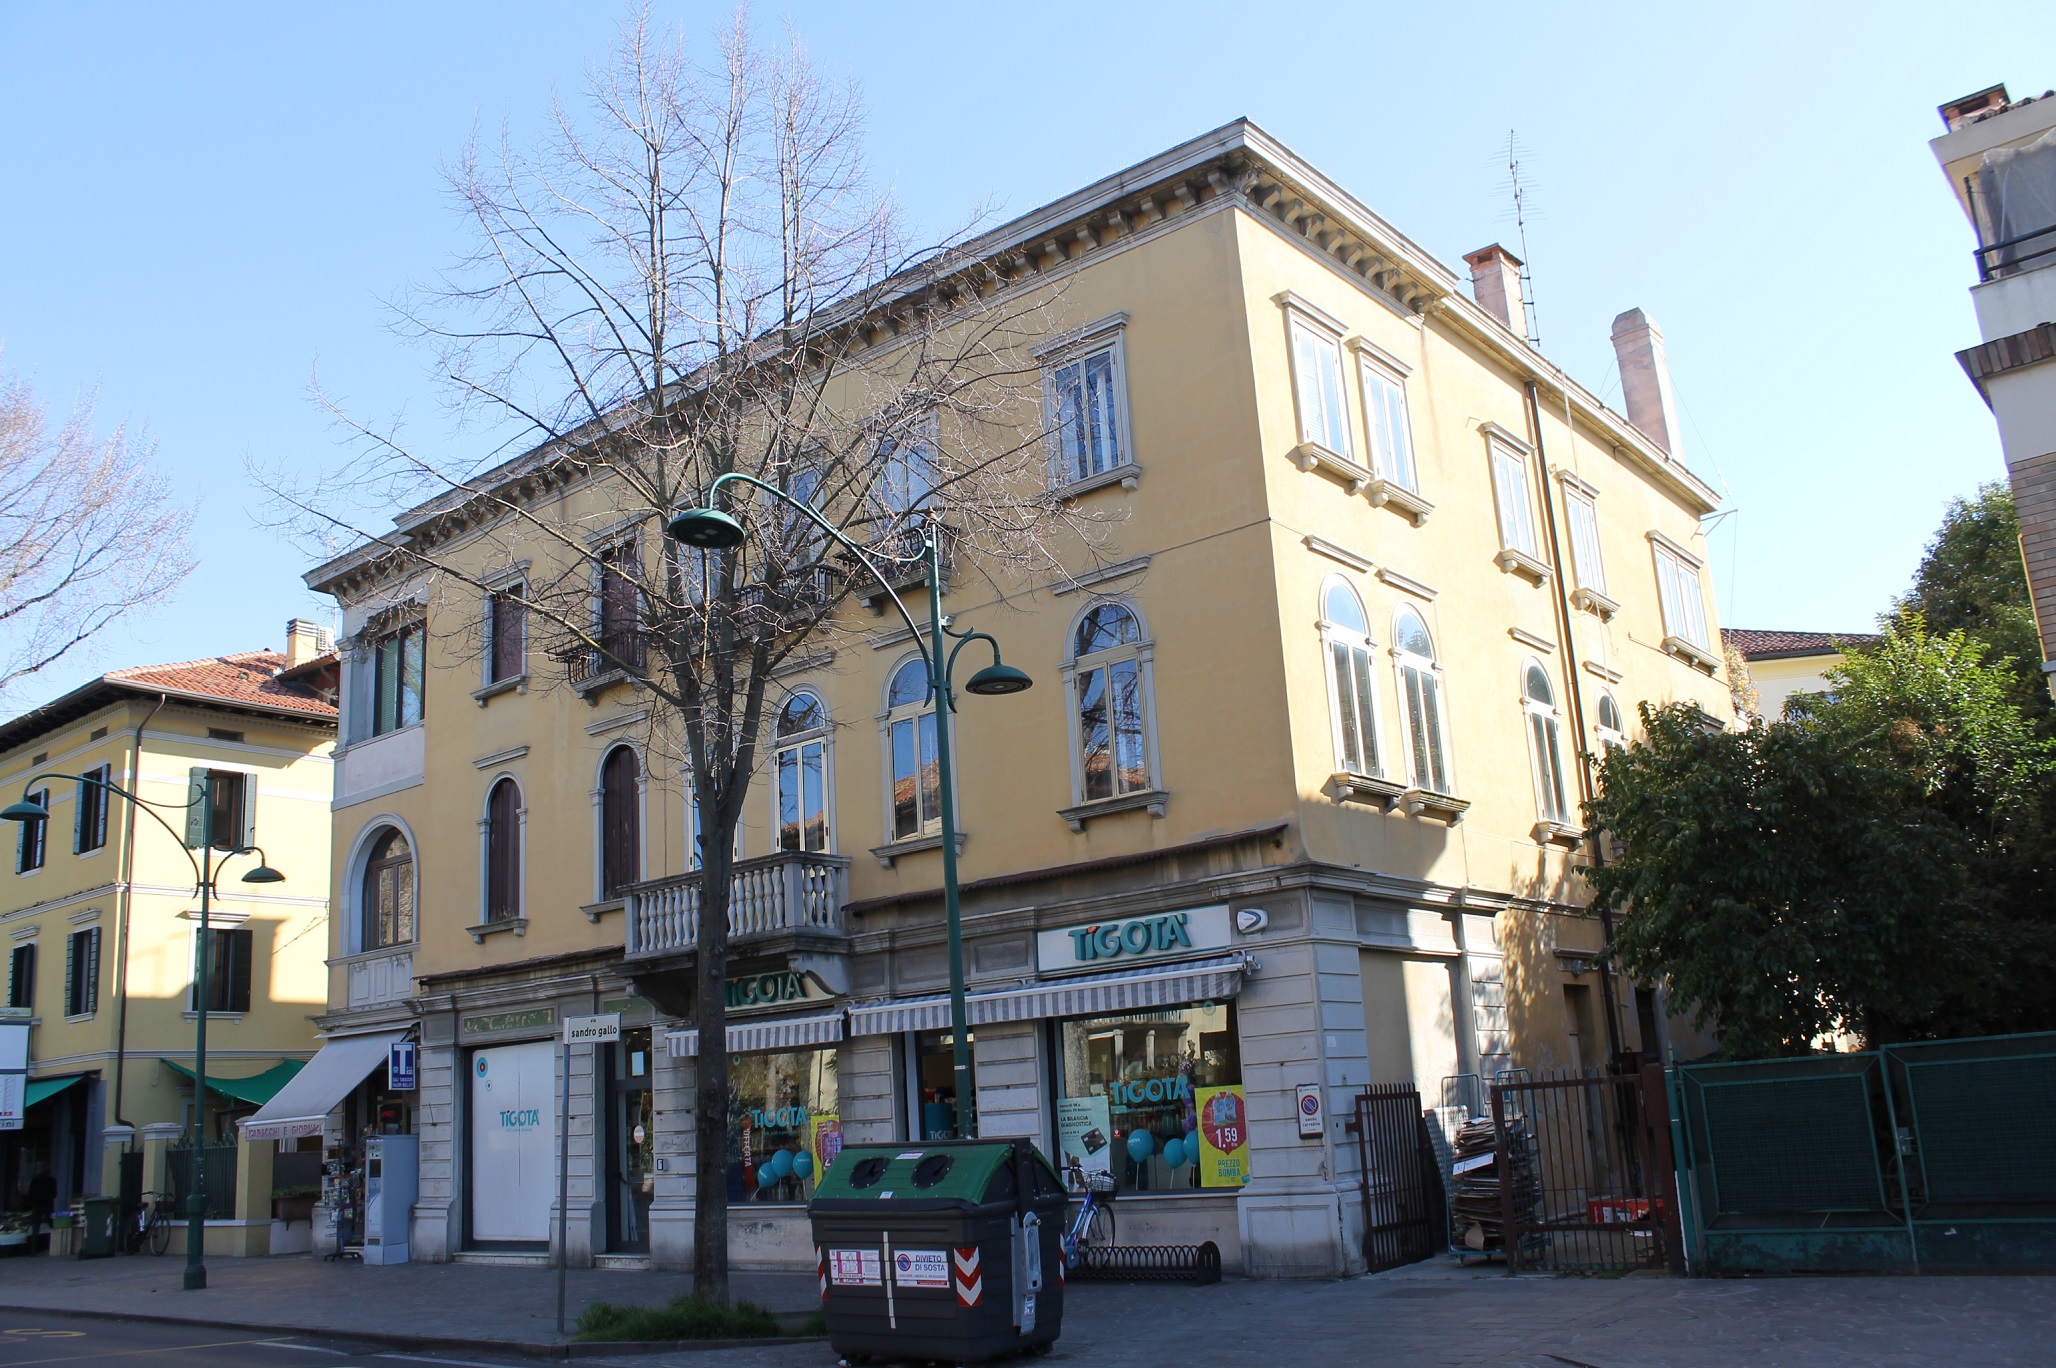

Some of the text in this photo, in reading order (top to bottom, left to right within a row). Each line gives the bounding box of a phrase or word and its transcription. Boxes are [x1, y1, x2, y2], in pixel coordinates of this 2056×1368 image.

[571, 1025, 618, 1038] sandro gallo
[394, 1044, 413, 1075] T
[284, 1126, 288, 1135] E
[1218, 1159, 1240, 1168] PREZZO
[1218, 1168, 1240, 1177] BOMBA
[915, 1254, 942, 1263] DIVIETO
[923, 1264, 946, 1272] SOSTA
